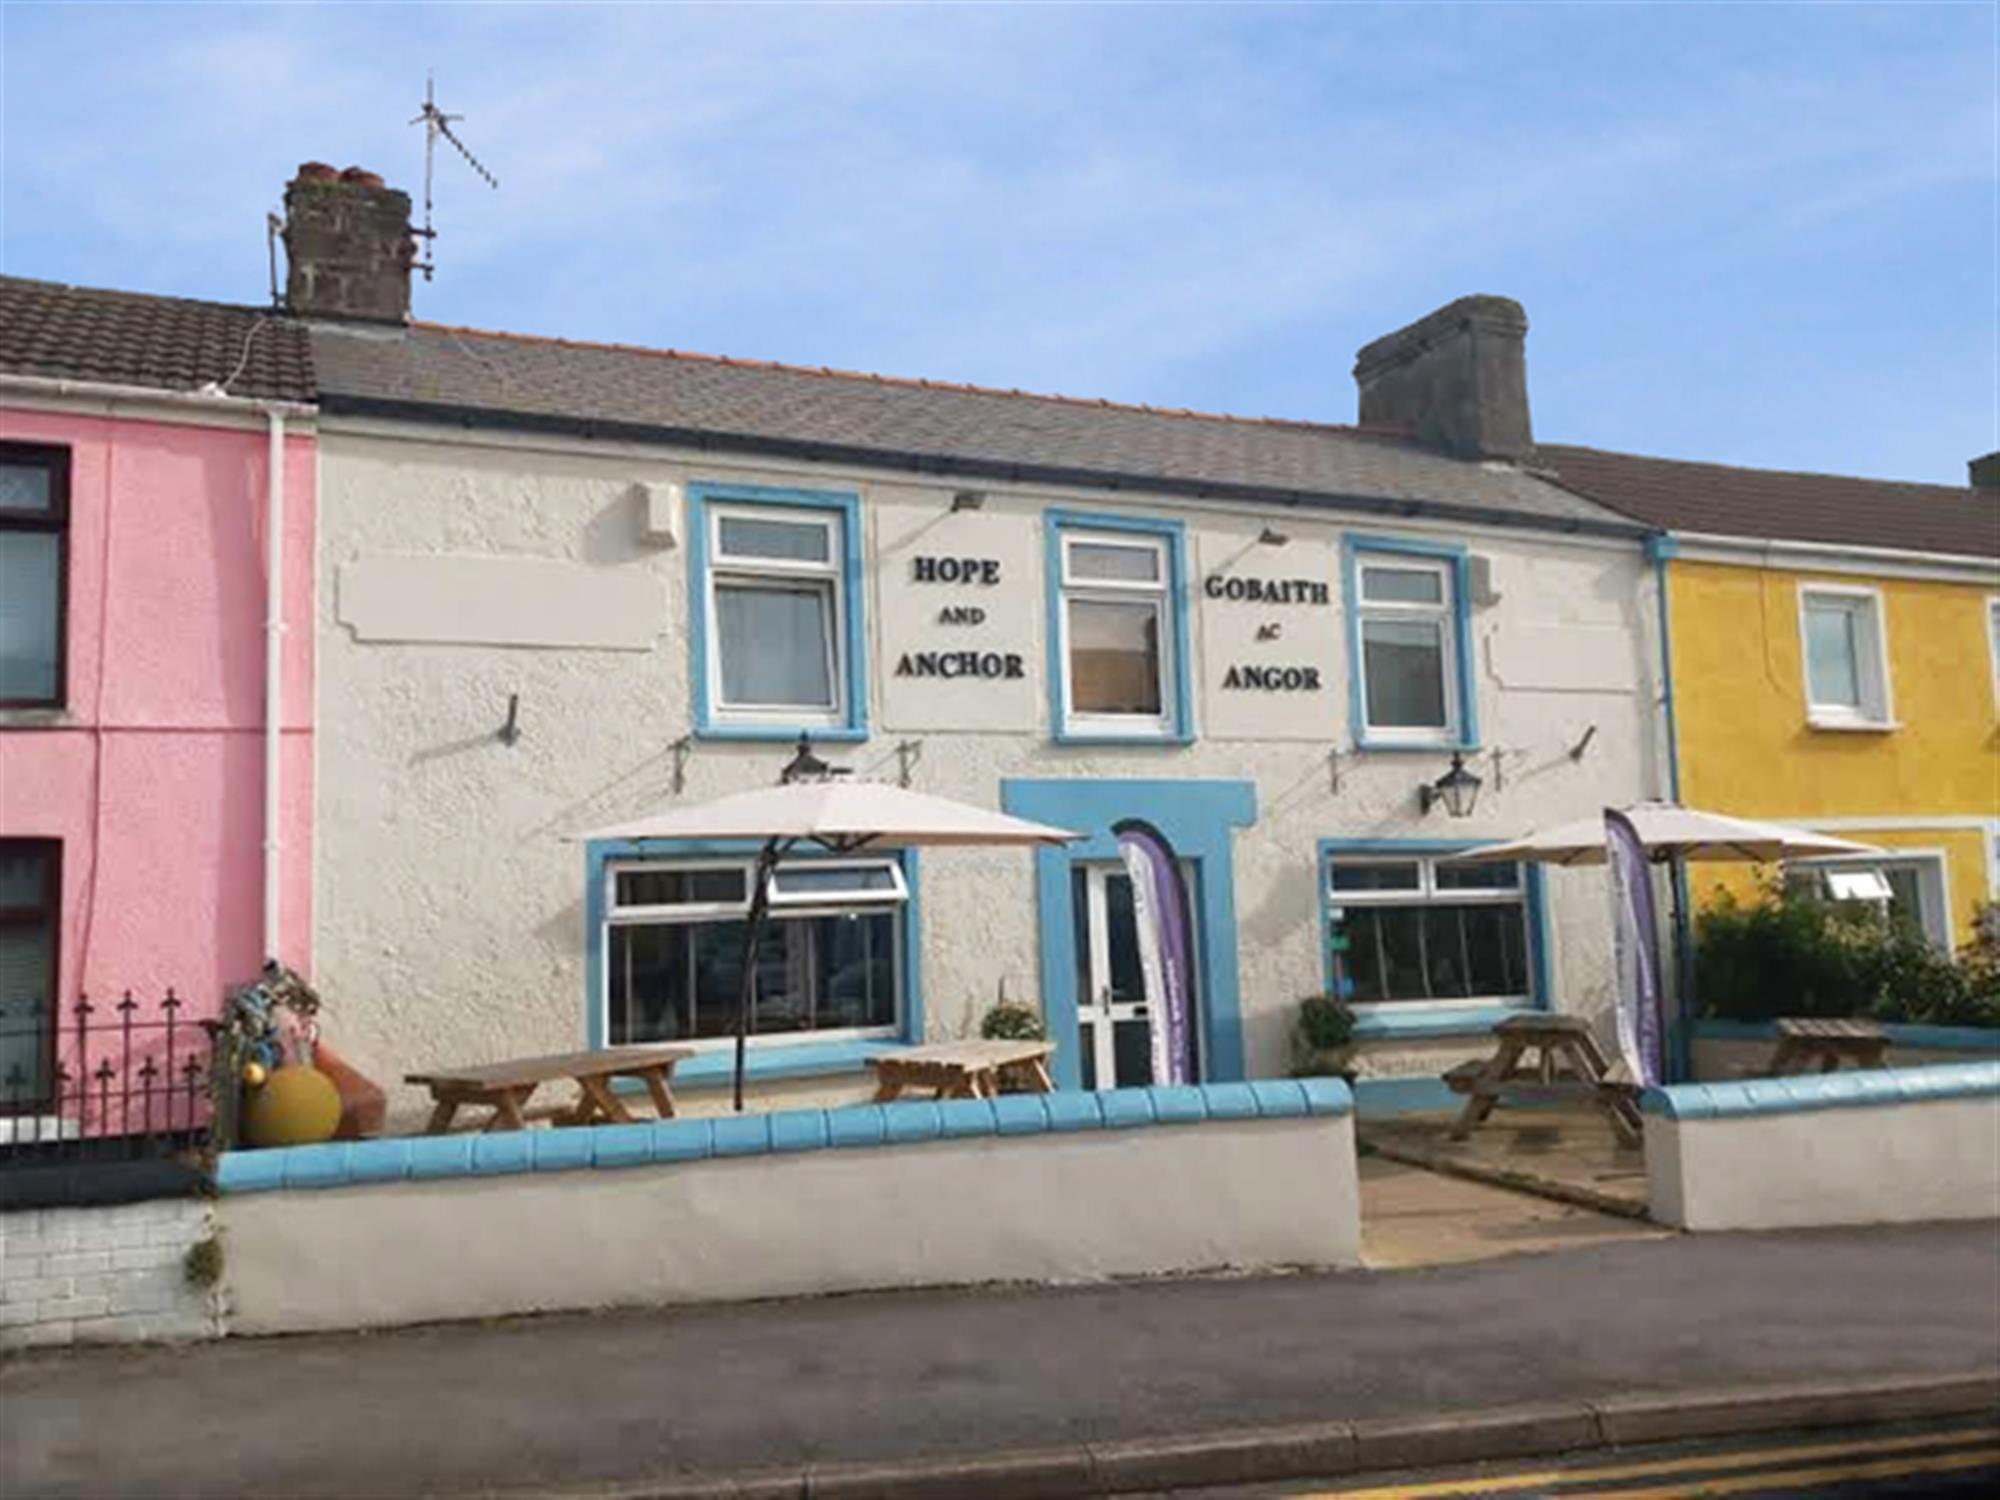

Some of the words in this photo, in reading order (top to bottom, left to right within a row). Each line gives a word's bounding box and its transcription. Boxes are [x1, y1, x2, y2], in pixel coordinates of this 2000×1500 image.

[914, 556, 1000, 586] HOPE
[1204, 575, 1330, 605] GOBAITH
[938, 607, 986, 625] AND
[1255, 623, 1281, 640] AC
[895, 651, 1026, 679] ANCHOR
[1222, 666, 1321, 691] ANGOR
